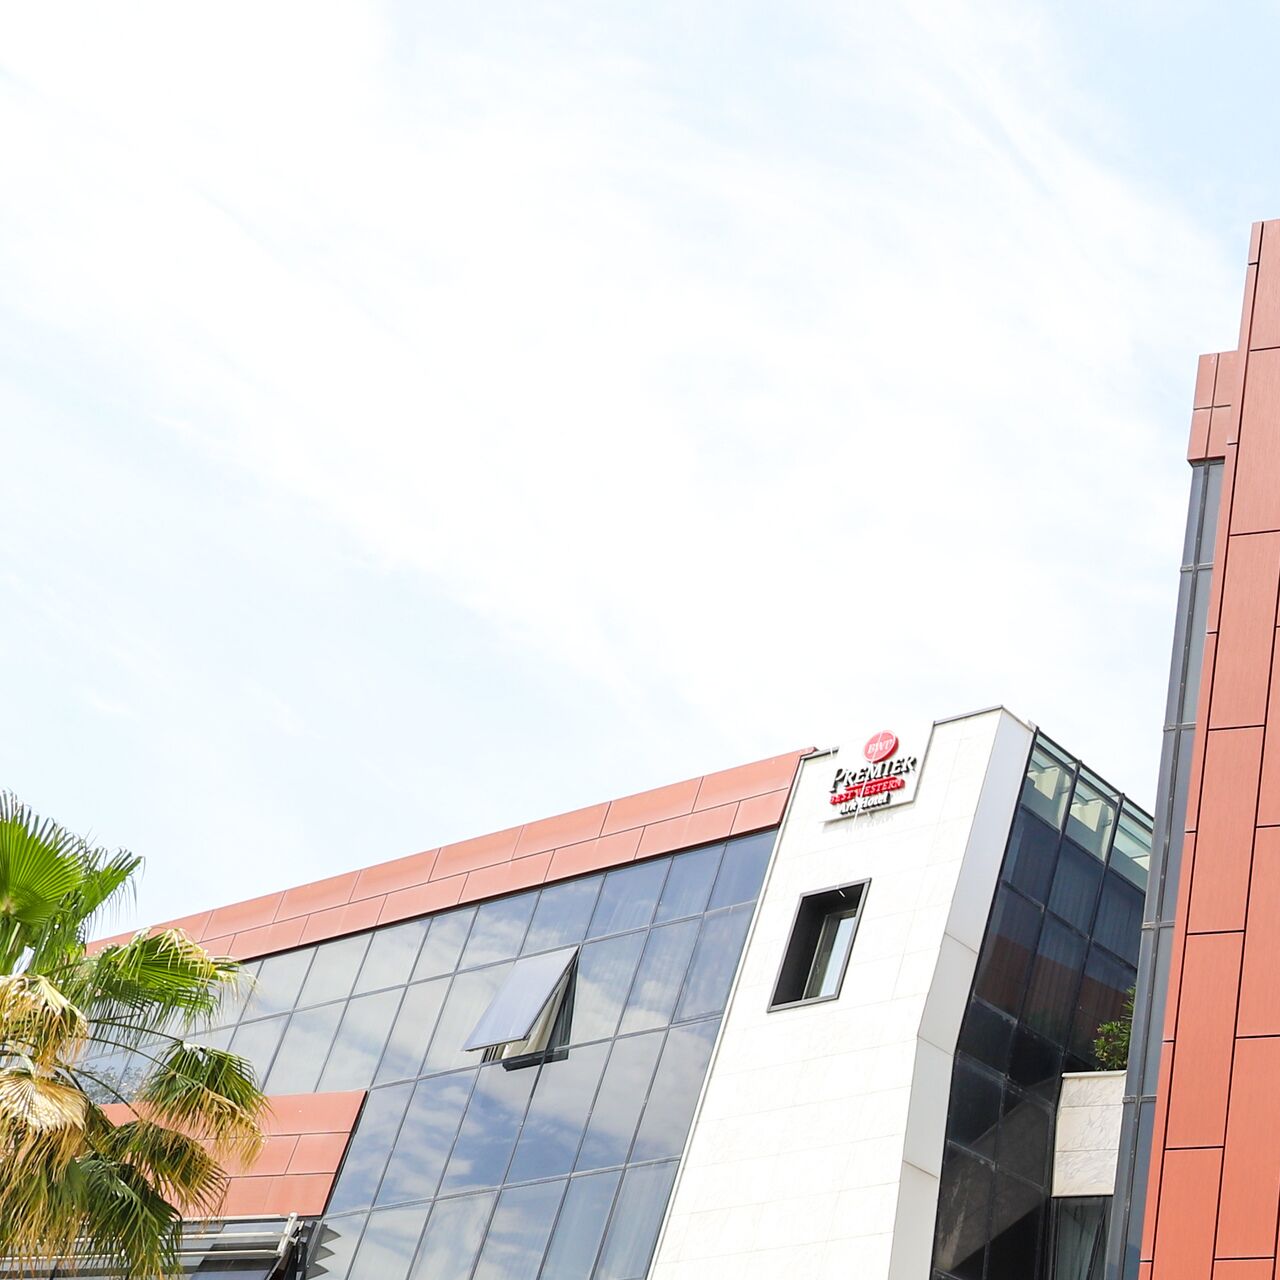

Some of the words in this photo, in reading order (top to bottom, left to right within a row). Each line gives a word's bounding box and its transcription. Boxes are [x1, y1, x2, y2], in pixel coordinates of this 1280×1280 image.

[830, 756, 917, 793] PREMIER
[855, 779, 902, 798] WESTERN
[861, 791, 890, 810] Hotel
